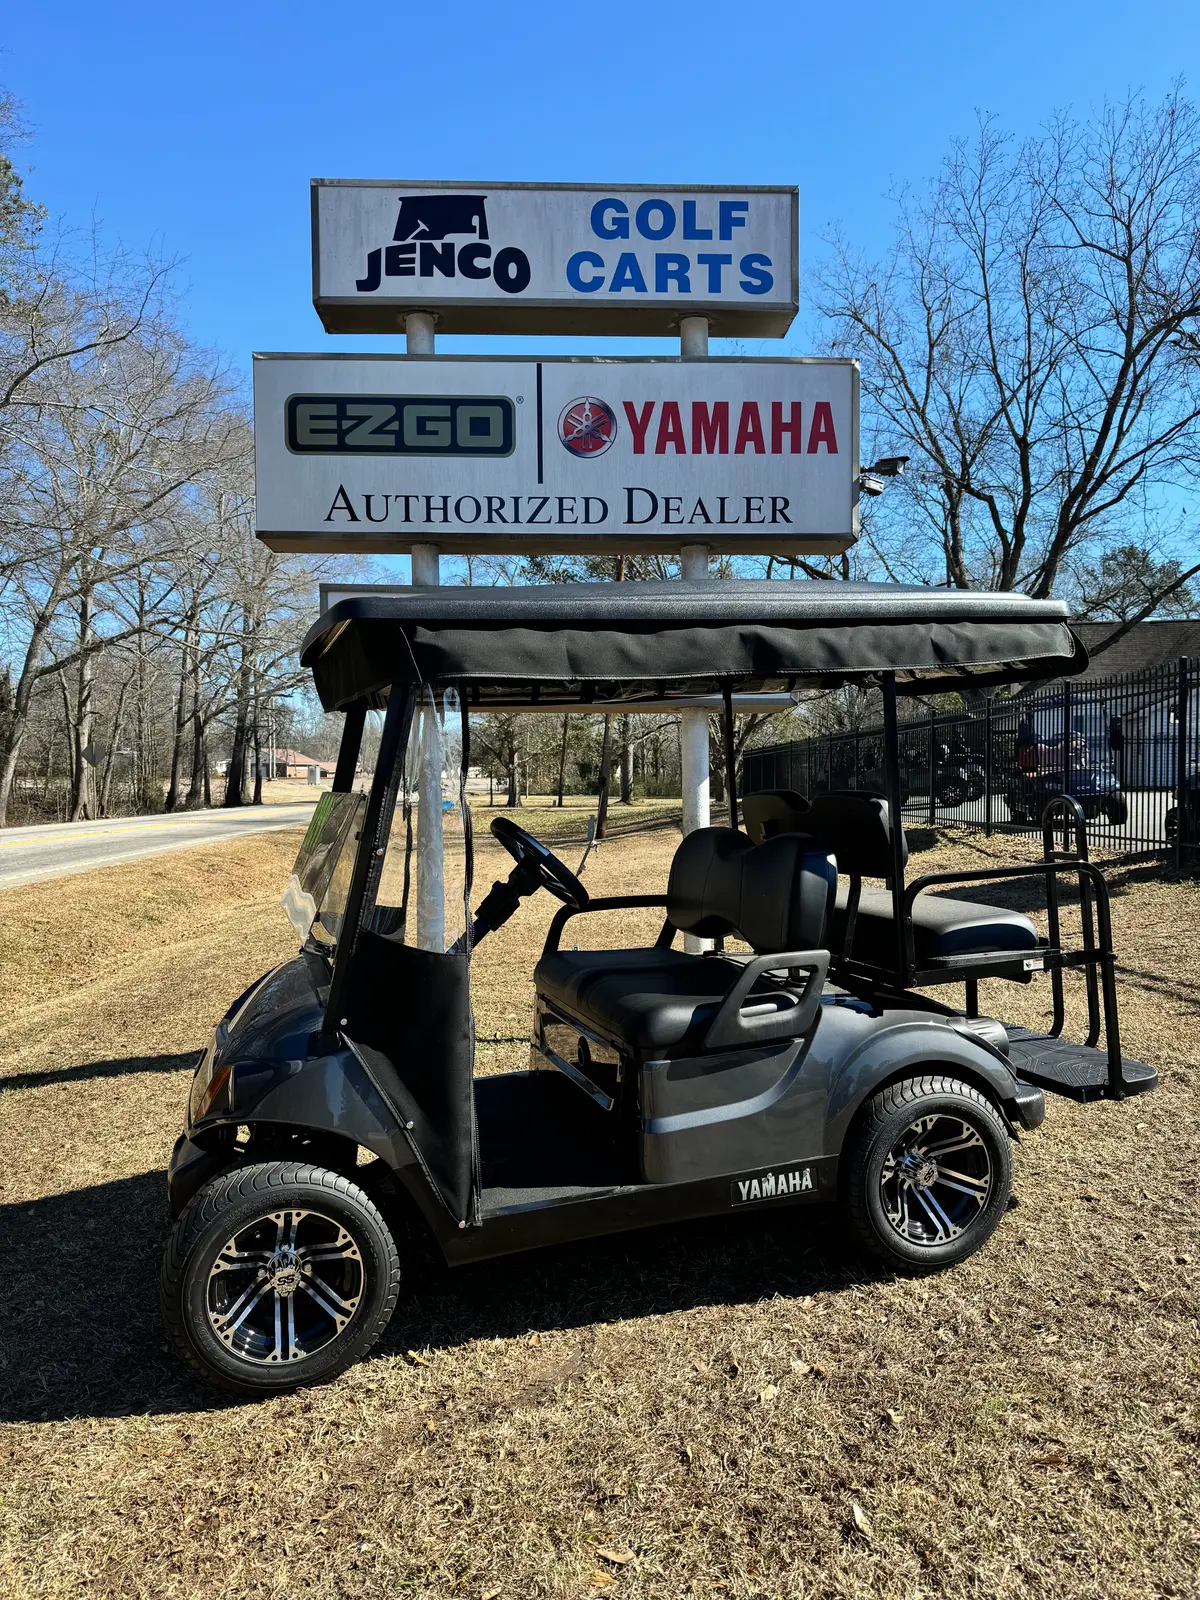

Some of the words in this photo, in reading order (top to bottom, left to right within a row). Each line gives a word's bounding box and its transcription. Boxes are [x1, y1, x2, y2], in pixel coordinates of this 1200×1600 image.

[590, 198, 749, 241] GOLF
[355, 242, 531, 294] JENCO
[566, 251, 774, 295] CARTS
[296, 403, 504, 448] EZGO
[622, 401, 839, 455] YAMAHA
[323, 484, 609, 525] AUTHORIZED
[622, 487, 794, 525] DEALER
[738, 1170, 813, 1201] YAMAHA
